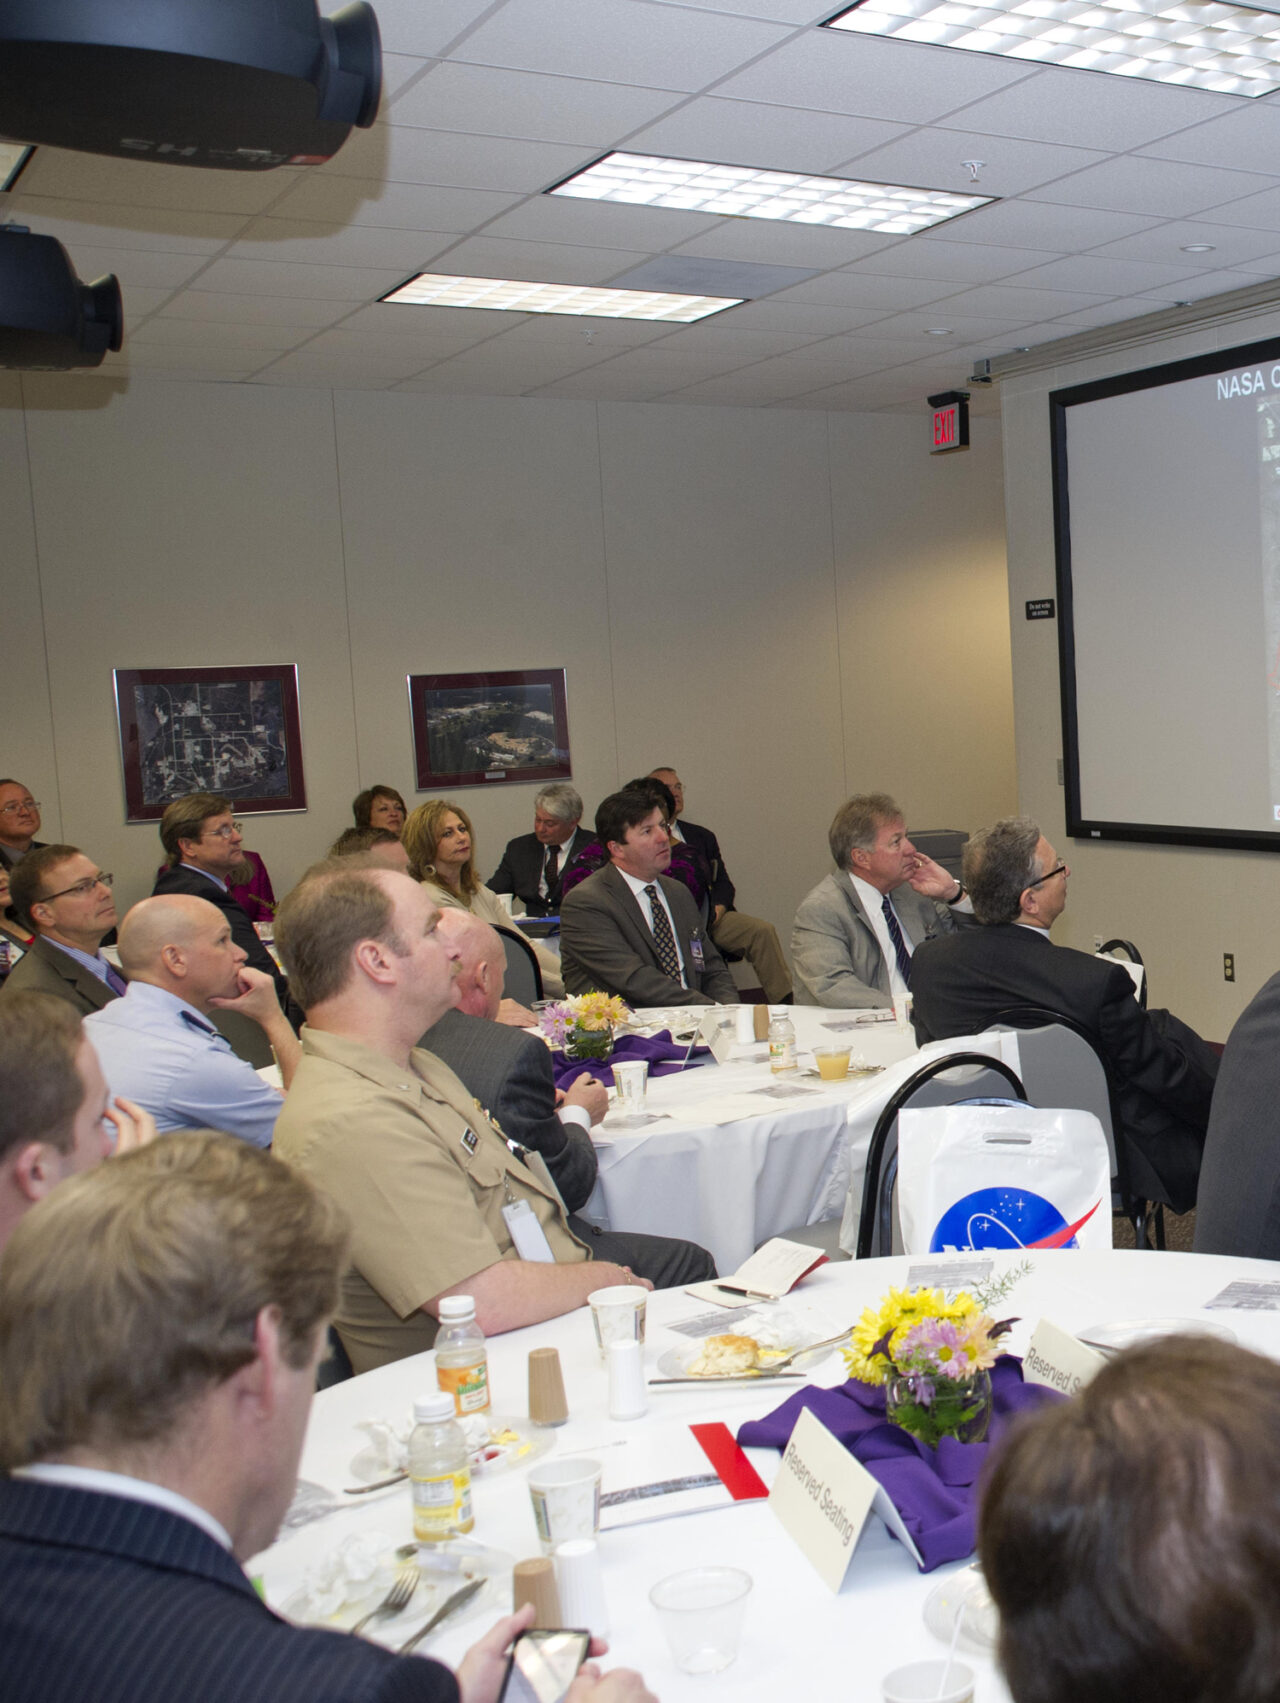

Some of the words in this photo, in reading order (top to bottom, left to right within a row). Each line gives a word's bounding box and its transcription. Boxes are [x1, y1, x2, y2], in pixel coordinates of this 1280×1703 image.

[1216, 369, 1266, 400] NASA
[934, 408, 955, 446] EXIT
[1025, 1346, 1071, 1391] Reserved
[784, 1442, 824, 1502] Reserved
[819, 1487, 854, 1547] Seating
